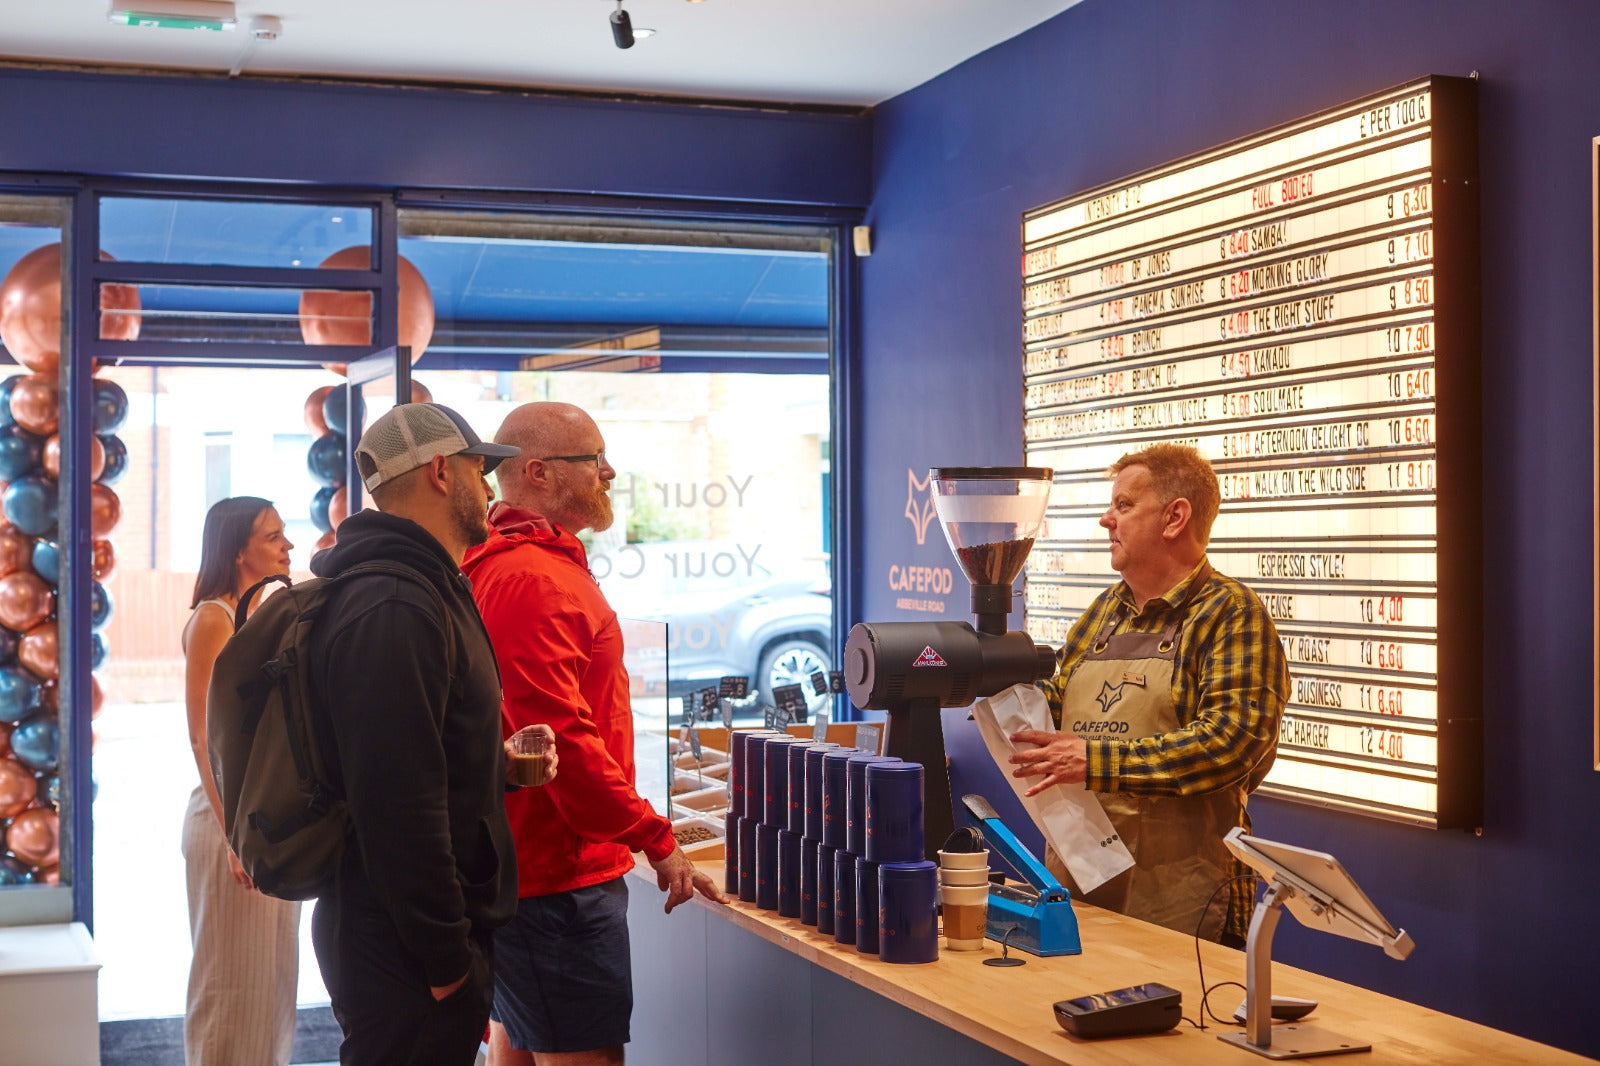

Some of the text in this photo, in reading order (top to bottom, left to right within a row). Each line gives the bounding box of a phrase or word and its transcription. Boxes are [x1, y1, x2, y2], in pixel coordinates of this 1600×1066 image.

[1370, 106, 1391, 134] PER
[1252, 172, 1314, 210] FULL BODIED
[1251, 185, 1429, 252] SAMBA! 9 8.30
[1146, 251, 1171, 277] JONES
[1220, 238, 1226, 260] 8
[1229, 229, 1249, 257] 8.40
[1251, 231, 1430, 292] MORNING GLORY 9 7.10
[1170, 281, 1206, 311] SUNRISE
[1220, 277, 1226, 299] 8
[1230, 270, 1250, 298] 6.20
[1252, 307, 1271, 333] THE
[1274, 301, 1302, 330] RIGHT
[1304, 294, 1335, 324] STUFF
[1389, 285, 1397, 310] 9
[1132, 311, 1249, 354] BRUNCH 8 4.00
[1253, 323, 1430, 373] XANADU 10 7.90
[1132, 352, 1251, 391] BRUNCH DC 8 4.50
[1253, 370, 1430, 414] SOULMATE 10 6.40
[1132, 402, 1174, 427] BROOKLYN
[1177, 397, 1207, 422] HUSTLE
[1223, 435, 1229, 457] 9
[1254, 417, 1431, 455] AFTERNOON DELIGHT DC 10 6.60
[1223, 474, 1251, 499] 9 7.30
[1254, 461, 1434, 496] WALK ON THE WILD SIDE 11 9.10
[888, 564, 953, 595] CAFEPOD
[1309, 553, 1345, 579] STYLE!
[927, 599, 945, 614] ROAD
[1359, 598, 1373, 623] 10
[1377, 596, 1403, 623] 4.00
[1298, 638, 1330, 663] ROAST
[1360, 639, 1372, 665] 10
[1377, 643, 1403, 671] 6.60
[1297, 679, 1403, 716] BUSINESS 11 8.60
[1072, 720, 1129, 734] CAFEPOD
[1359, 728, 1373, 754] 12
[1377, 731, 1403, 760] 4.00
